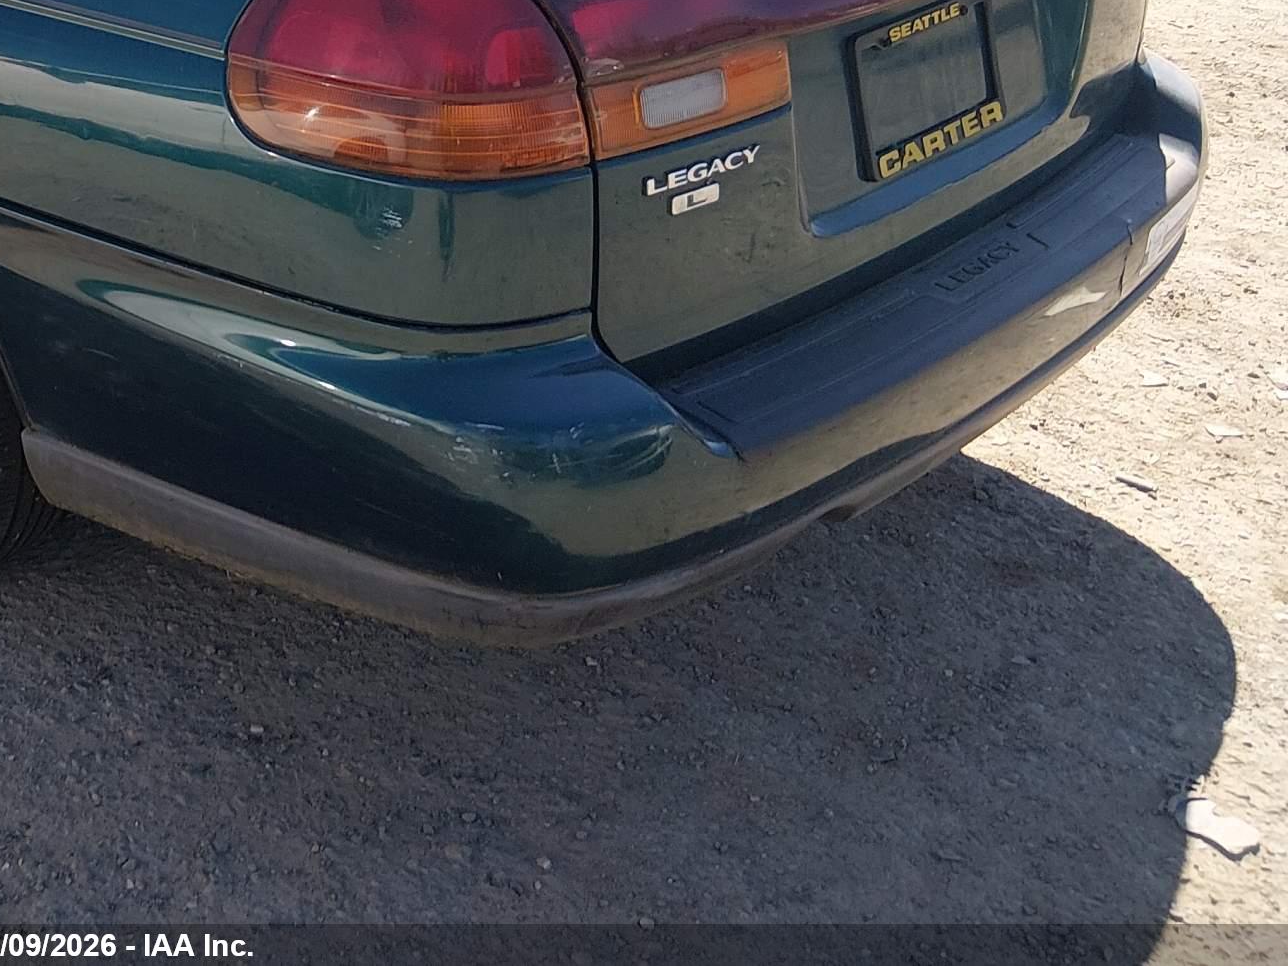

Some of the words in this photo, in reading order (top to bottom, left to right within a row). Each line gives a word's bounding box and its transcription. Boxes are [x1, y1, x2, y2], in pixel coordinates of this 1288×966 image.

[888, 2, 962, 43] SEATTLE
[878, 101, 1004, 179] CARTER
[644, 144, 761, 197] LEGACY
[934, 241, 1021, 292] LEGACY
